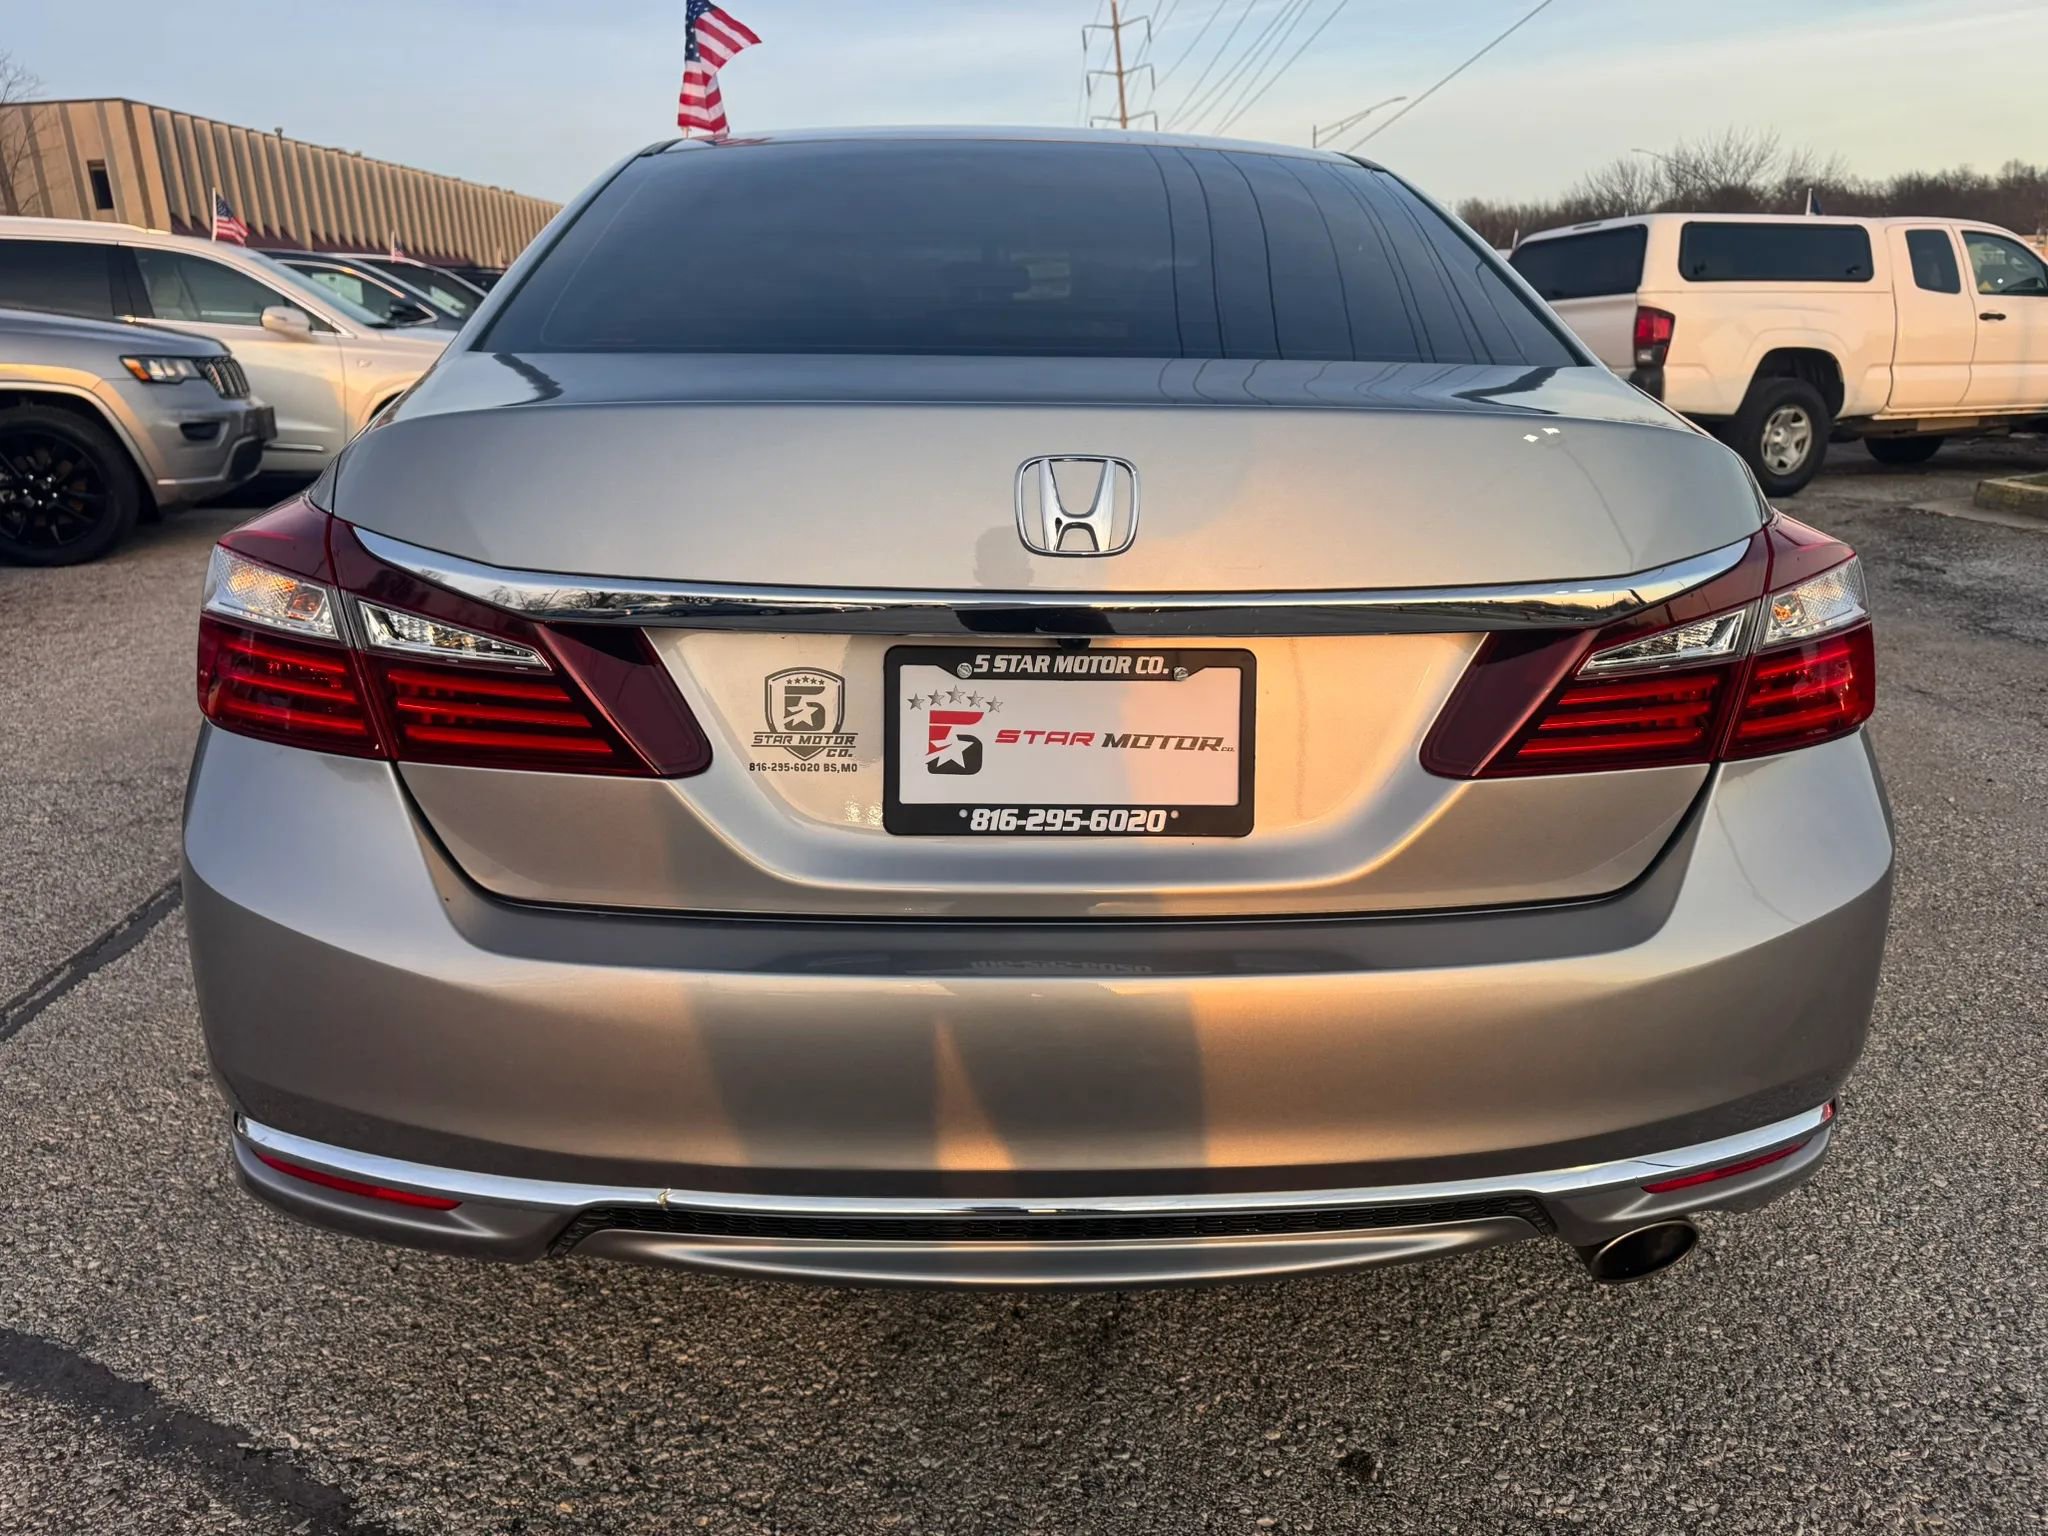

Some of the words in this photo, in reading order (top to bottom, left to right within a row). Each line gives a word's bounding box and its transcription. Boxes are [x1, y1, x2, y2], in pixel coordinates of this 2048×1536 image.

[974, 654, 991, 673] 5
[992, 655, 1050, 673] STAR
[1053, 655, 1132, 674] MOTOR
[1135, 656, 1170, 675] CO.
[753, 735, 793, 744] STAR
[798, 735, 855, 745] MOTOR
[994, 729, 1096, 748] STAR
[1101, 733, 1224, 752] MOTOR
[825, 748, 853, 758] CO.
[970, 809, 1167, 832] 816-295-6020
